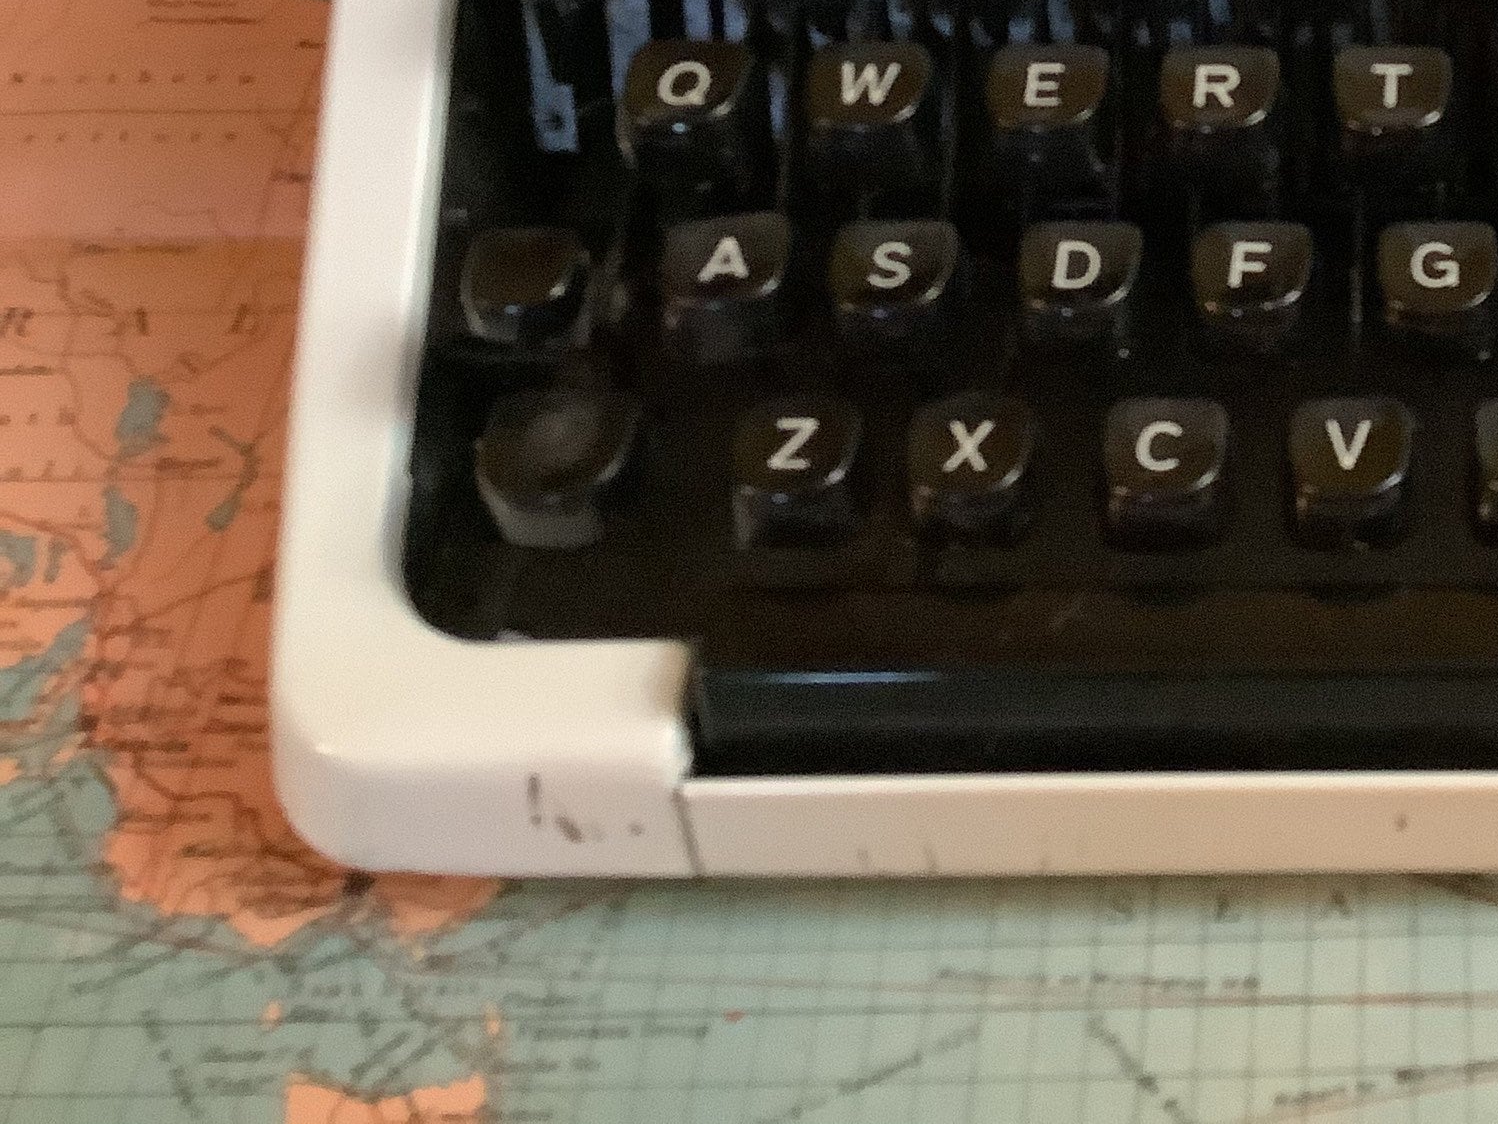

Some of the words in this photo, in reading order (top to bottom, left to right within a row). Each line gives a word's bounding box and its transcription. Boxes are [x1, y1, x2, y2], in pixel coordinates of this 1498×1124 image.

[657, 60, 712, 106] Q
[841, 61, 901, 105] W
[1023, 62, 1065, 107] E
[1193, 64, 1240, 108] R
[1370, 62, 1413, 108] T
[698, 236, 748, 282] A
[867, 241, 912, 288] S
[1052, 239, 1101, 289] D
[1228, 240, 1272, 288] F
[1410, 241, 1460, 289] G
[767, 417, 819, 470] Z
[943, 420, 994, 472] X
[1135, 421, 1183, 472] C
[1326, 419, 1372, 470] V
